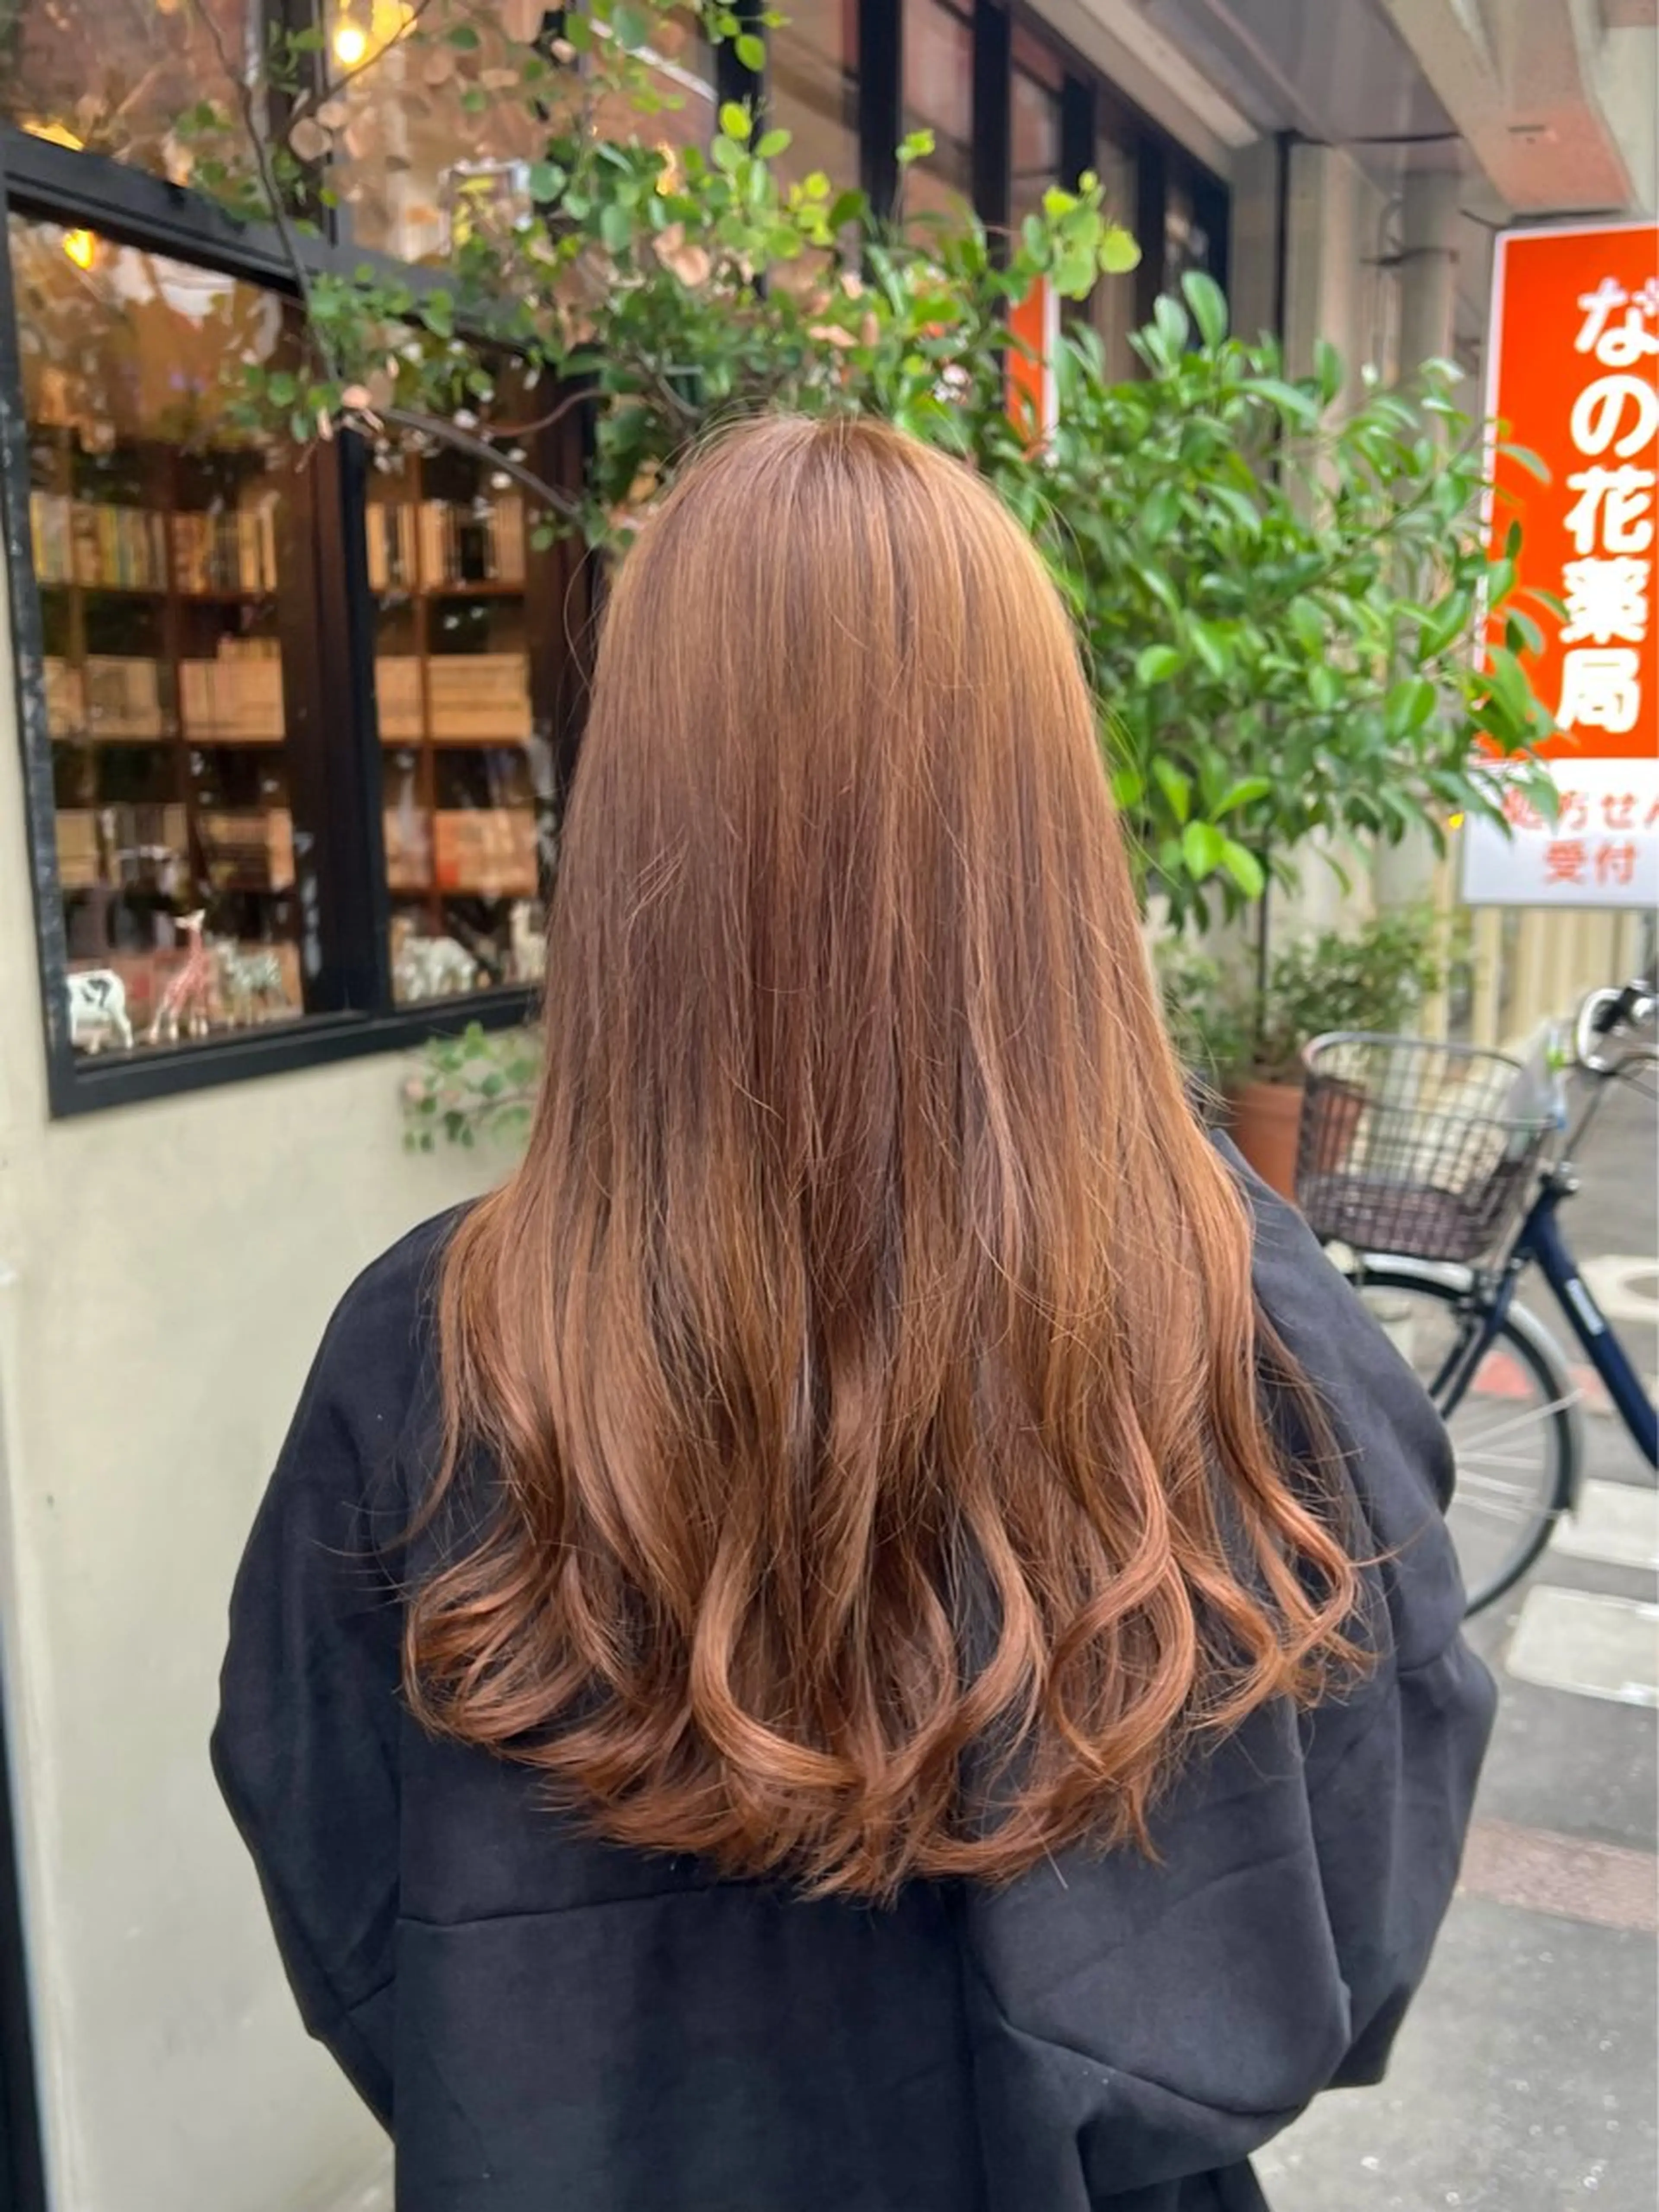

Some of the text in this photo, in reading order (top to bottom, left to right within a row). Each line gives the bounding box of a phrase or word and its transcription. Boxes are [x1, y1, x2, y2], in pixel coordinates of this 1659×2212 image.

[1554, 276, 1659, 733] なの花薬局
[1544, 839, 1637, 886] 受付
